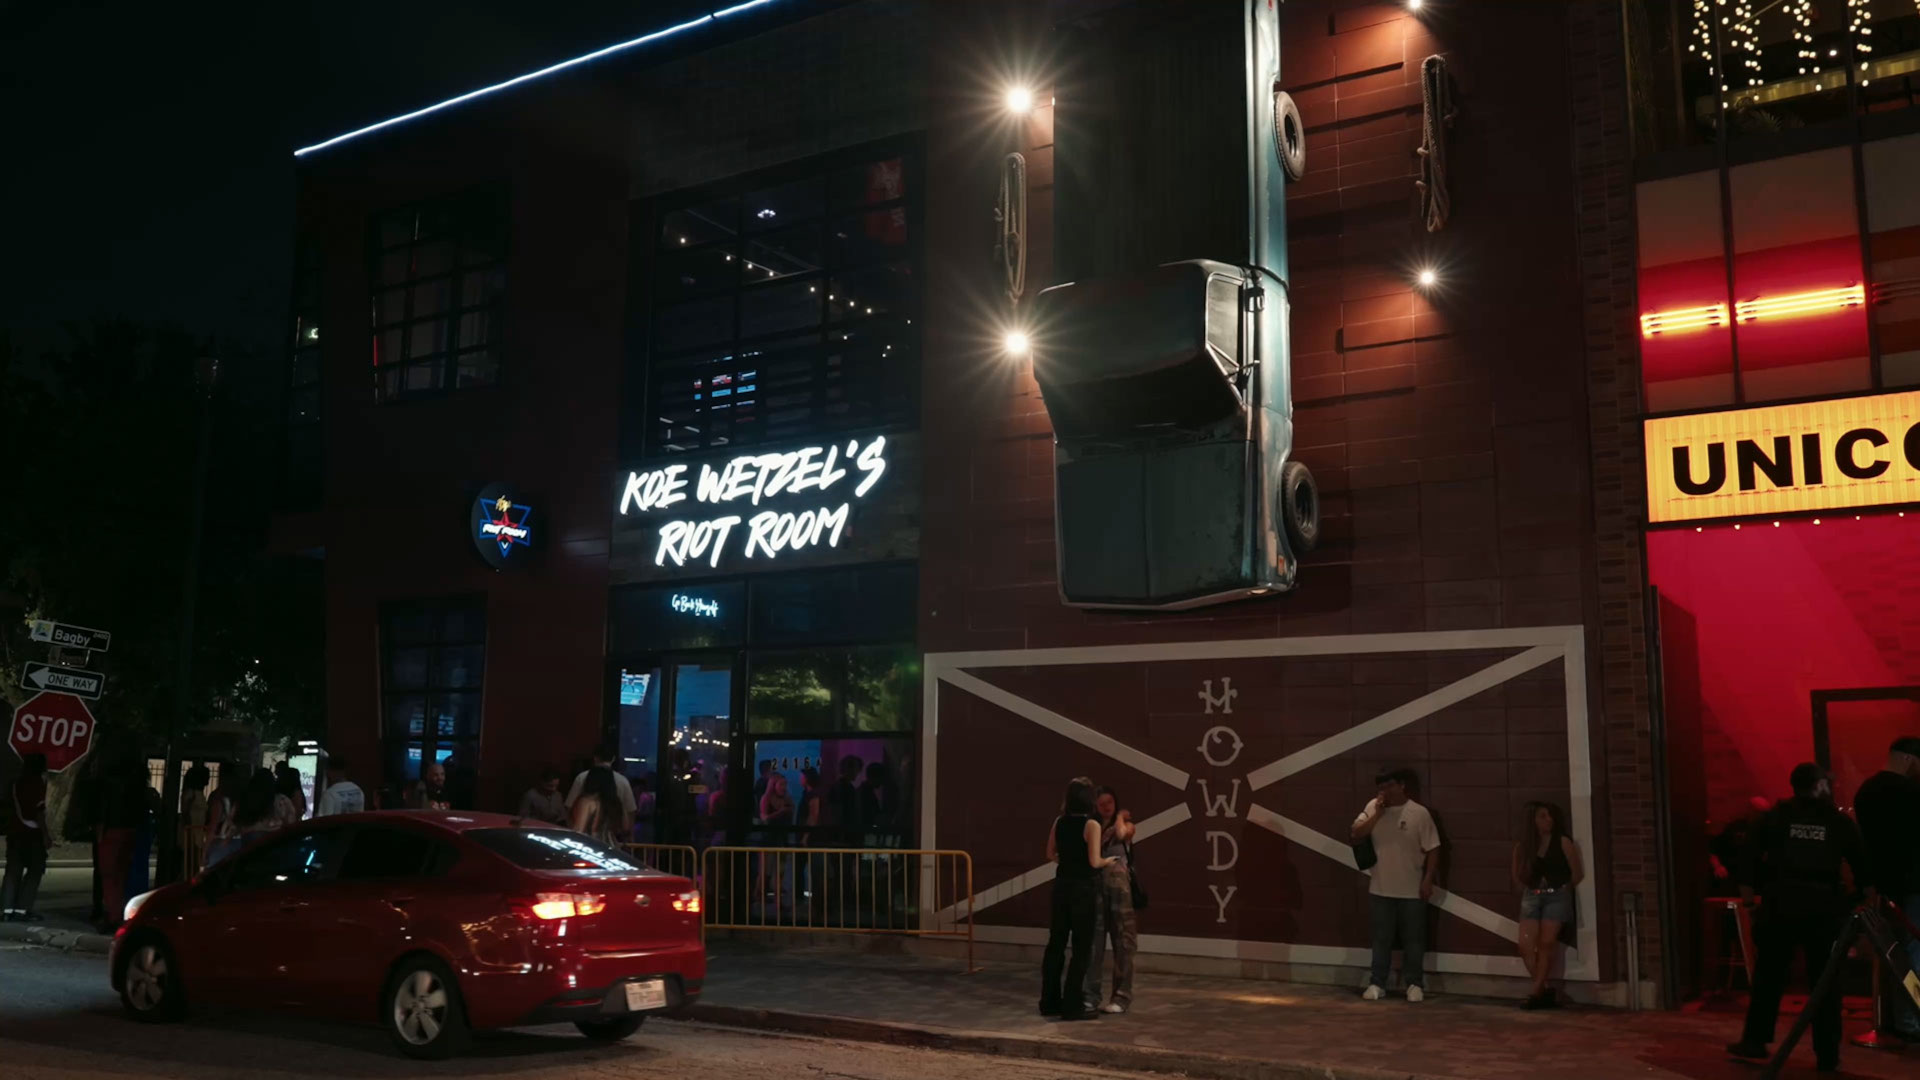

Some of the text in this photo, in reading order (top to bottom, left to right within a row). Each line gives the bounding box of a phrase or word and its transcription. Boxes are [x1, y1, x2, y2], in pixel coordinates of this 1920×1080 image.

[619, 436, 886, 514] KOE WETZEL'S
[1672, 421, 1920, 495] UNIC
[655, 503, 849, 567] RIOT ROOM
[54, 629, 91, 647] Bagby
[48, 674, 94, 689] ONE WAY
[17, 714, 88, 747] STOP
[1197, 677, 1243, 922] HOWDY
[1790, 828, 1825, 841] POLICE
